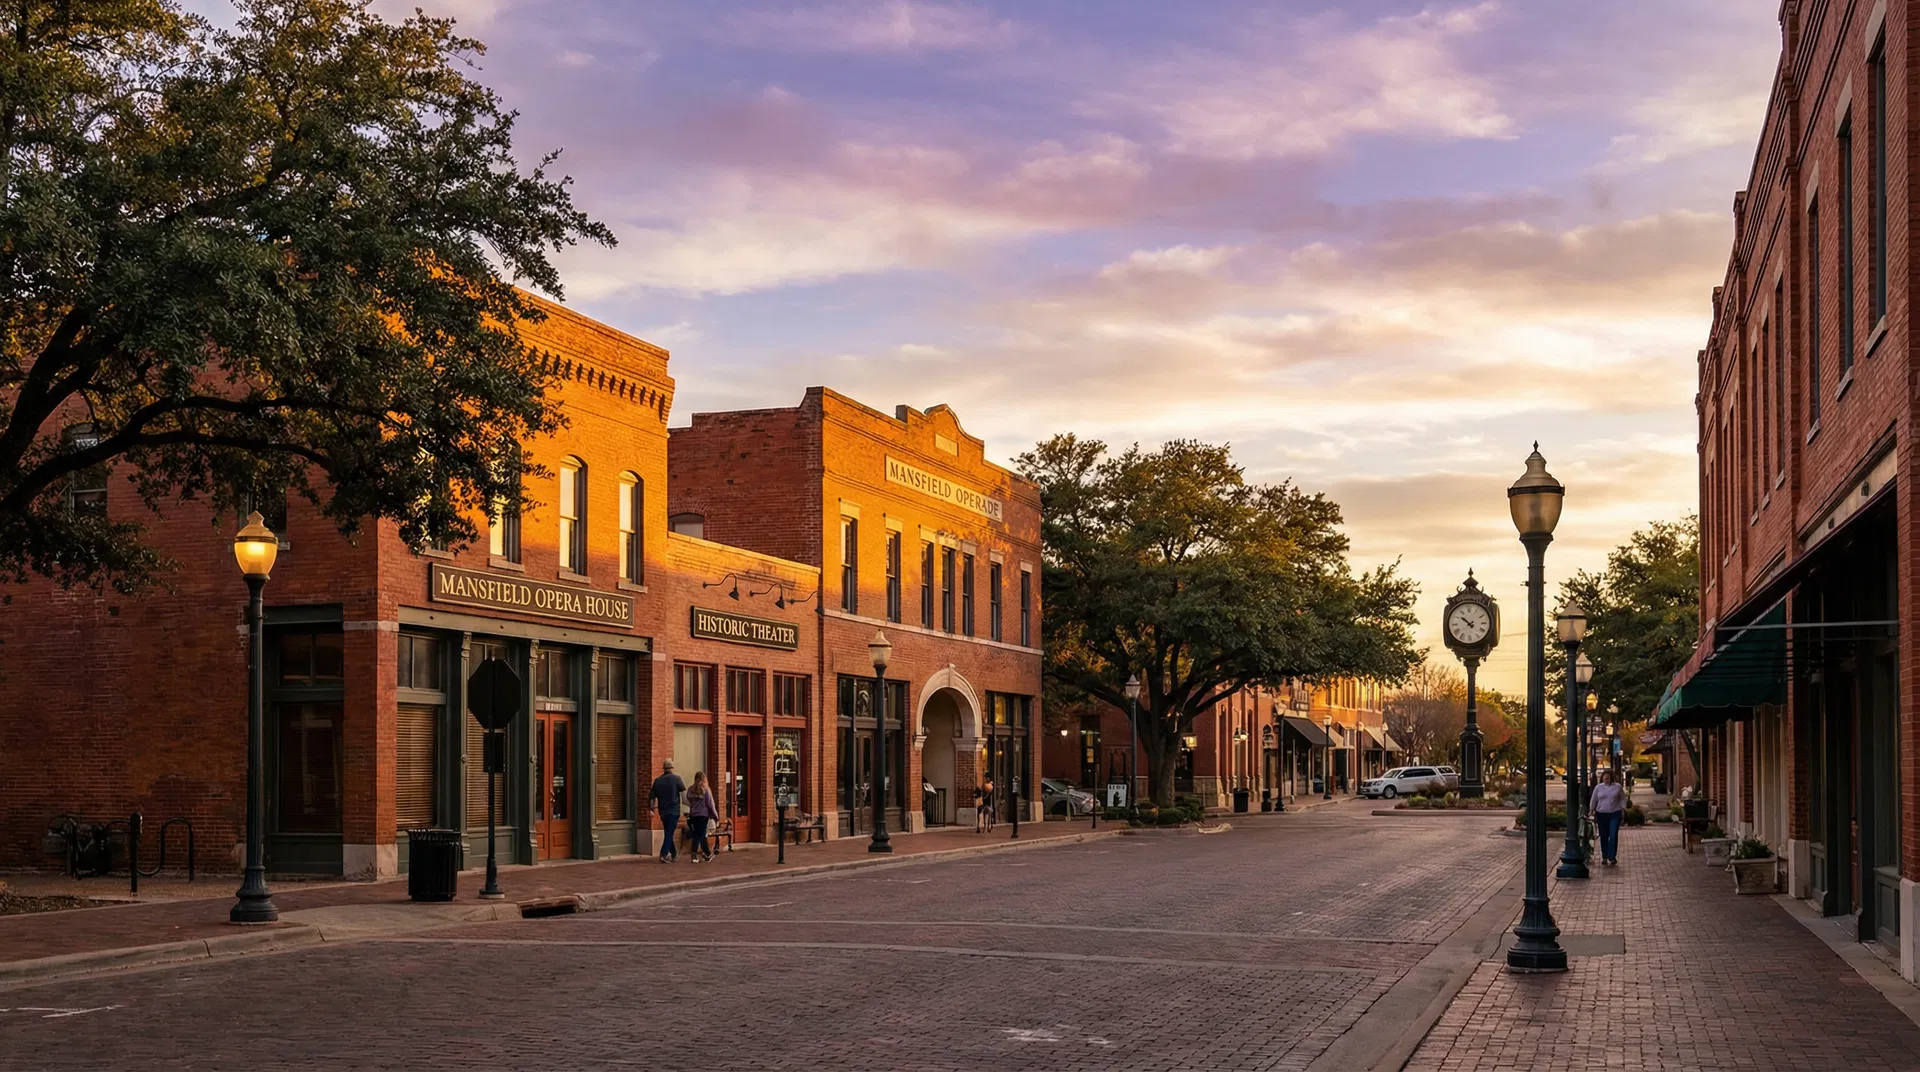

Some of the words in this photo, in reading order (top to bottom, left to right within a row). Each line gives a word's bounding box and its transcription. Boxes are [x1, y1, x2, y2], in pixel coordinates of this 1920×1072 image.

[890, 461, 951, 498] MANSFIELD
[955, 488, 999, 517] OPERADE
[440, 572, 531, 606] MANSFIELD
[534, 588, 582, 613] OPERA
[585, 595, 629, 620] HOUSE
[698, 614, 750, 637] HISTORIC
[751, 623, 795, 644] THEATER
